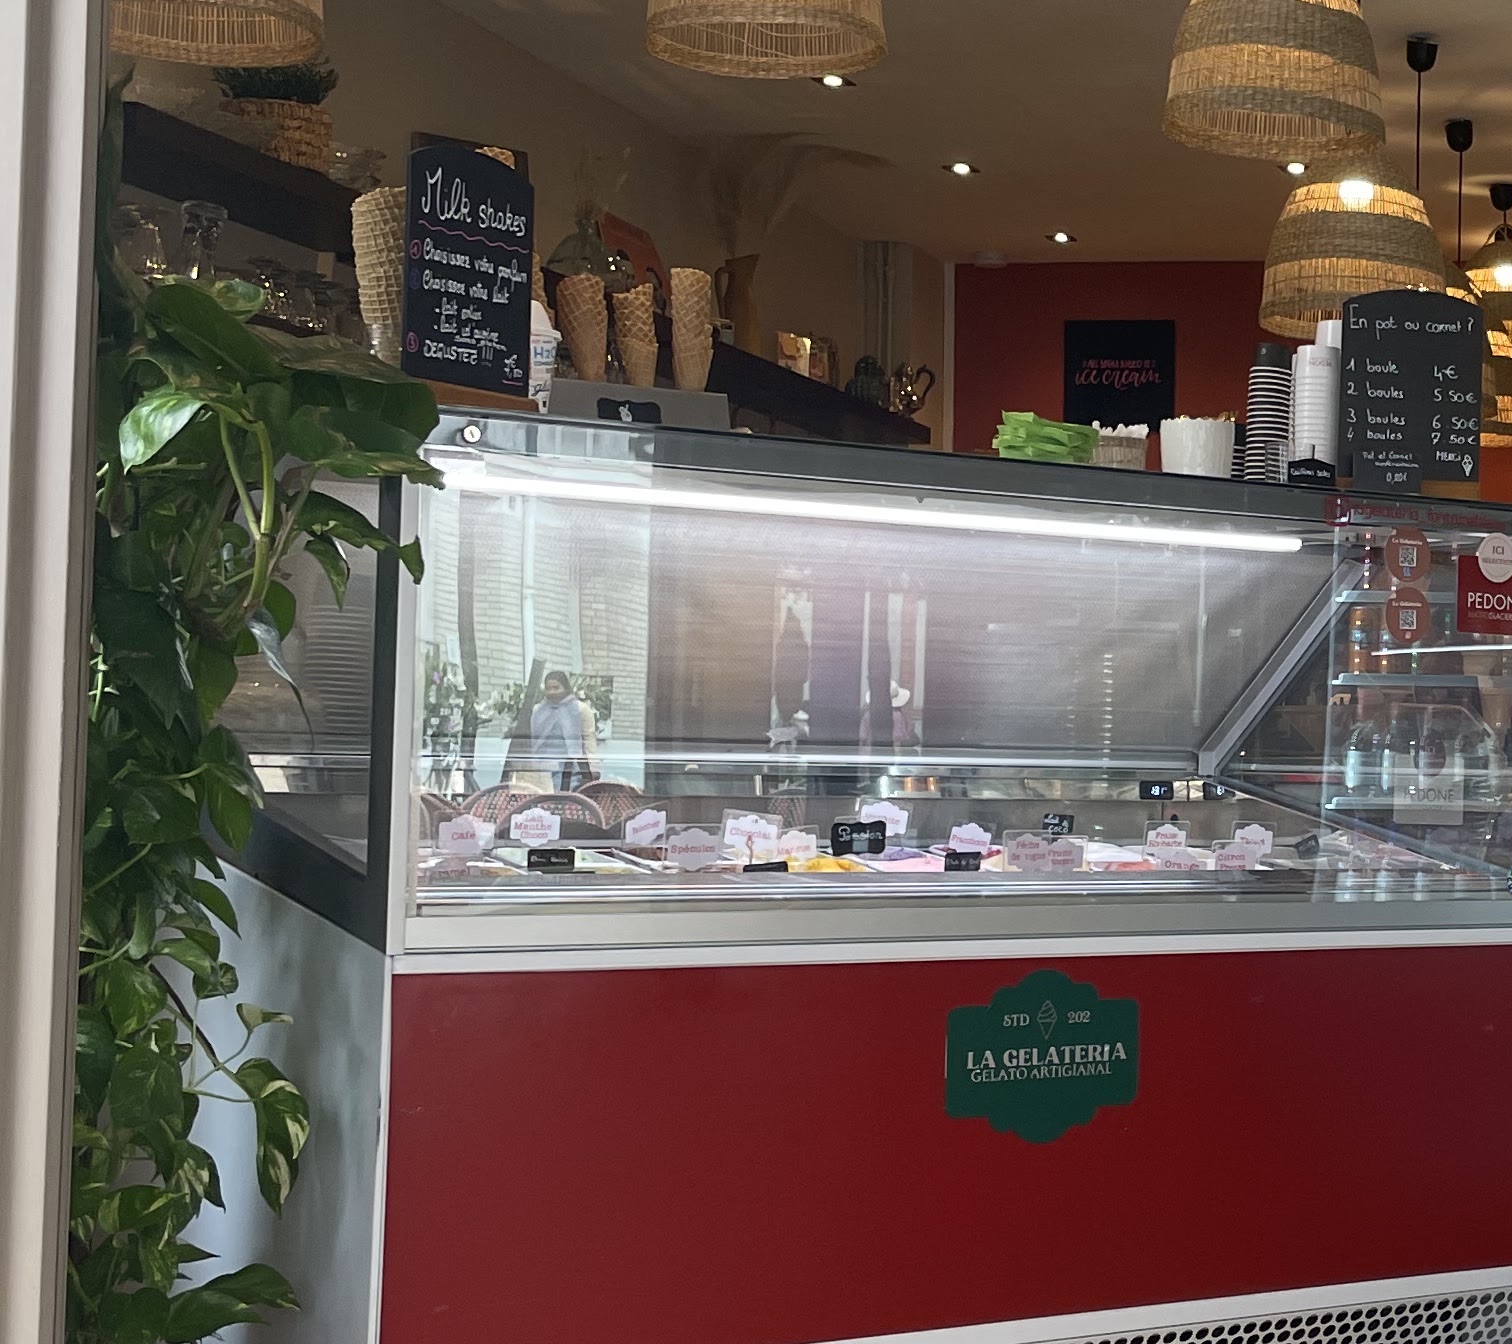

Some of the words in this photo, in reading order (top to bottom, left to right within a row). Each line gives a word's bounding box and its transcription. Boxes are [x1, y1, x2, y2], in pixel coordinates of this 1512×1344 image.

[421, 166, 472, 223] Milk
[478, 197, 527, 237] shakes
[1350, 303, 1368, 329] En
[1375, 316, 1398, 340] pot
[1404, 321, 1420, 330] ou
[1425, 320, 1461, 333] cornet
[1346, 357, 1355, 371] 1
[1366, 357, 1399, 374] boule
[1075, 369, 1100, 385] ice
[1102, 369, 1162, 390] cream
[1347, 382, 1358, 395] 2
[1366, 381, 1404, 399] boules
[1347, 408, 1357, 423] 3
[1366, 408, 1406, 426] boules
[1367, 428, 1402, 440] boules
[1492, 545, 1505, 555] ICI
[514, 822, 552, 830] Menthe
[1067, 1010, 1091, 1023] 202
[967, 1050, 996, 1070] LA
[1003, 1042, 1127, 1068] GELATERIA
[971, 1068, 1028, 1083] GELATO
[1030, 1062, 1112, 1080] ARTIGIANAL
